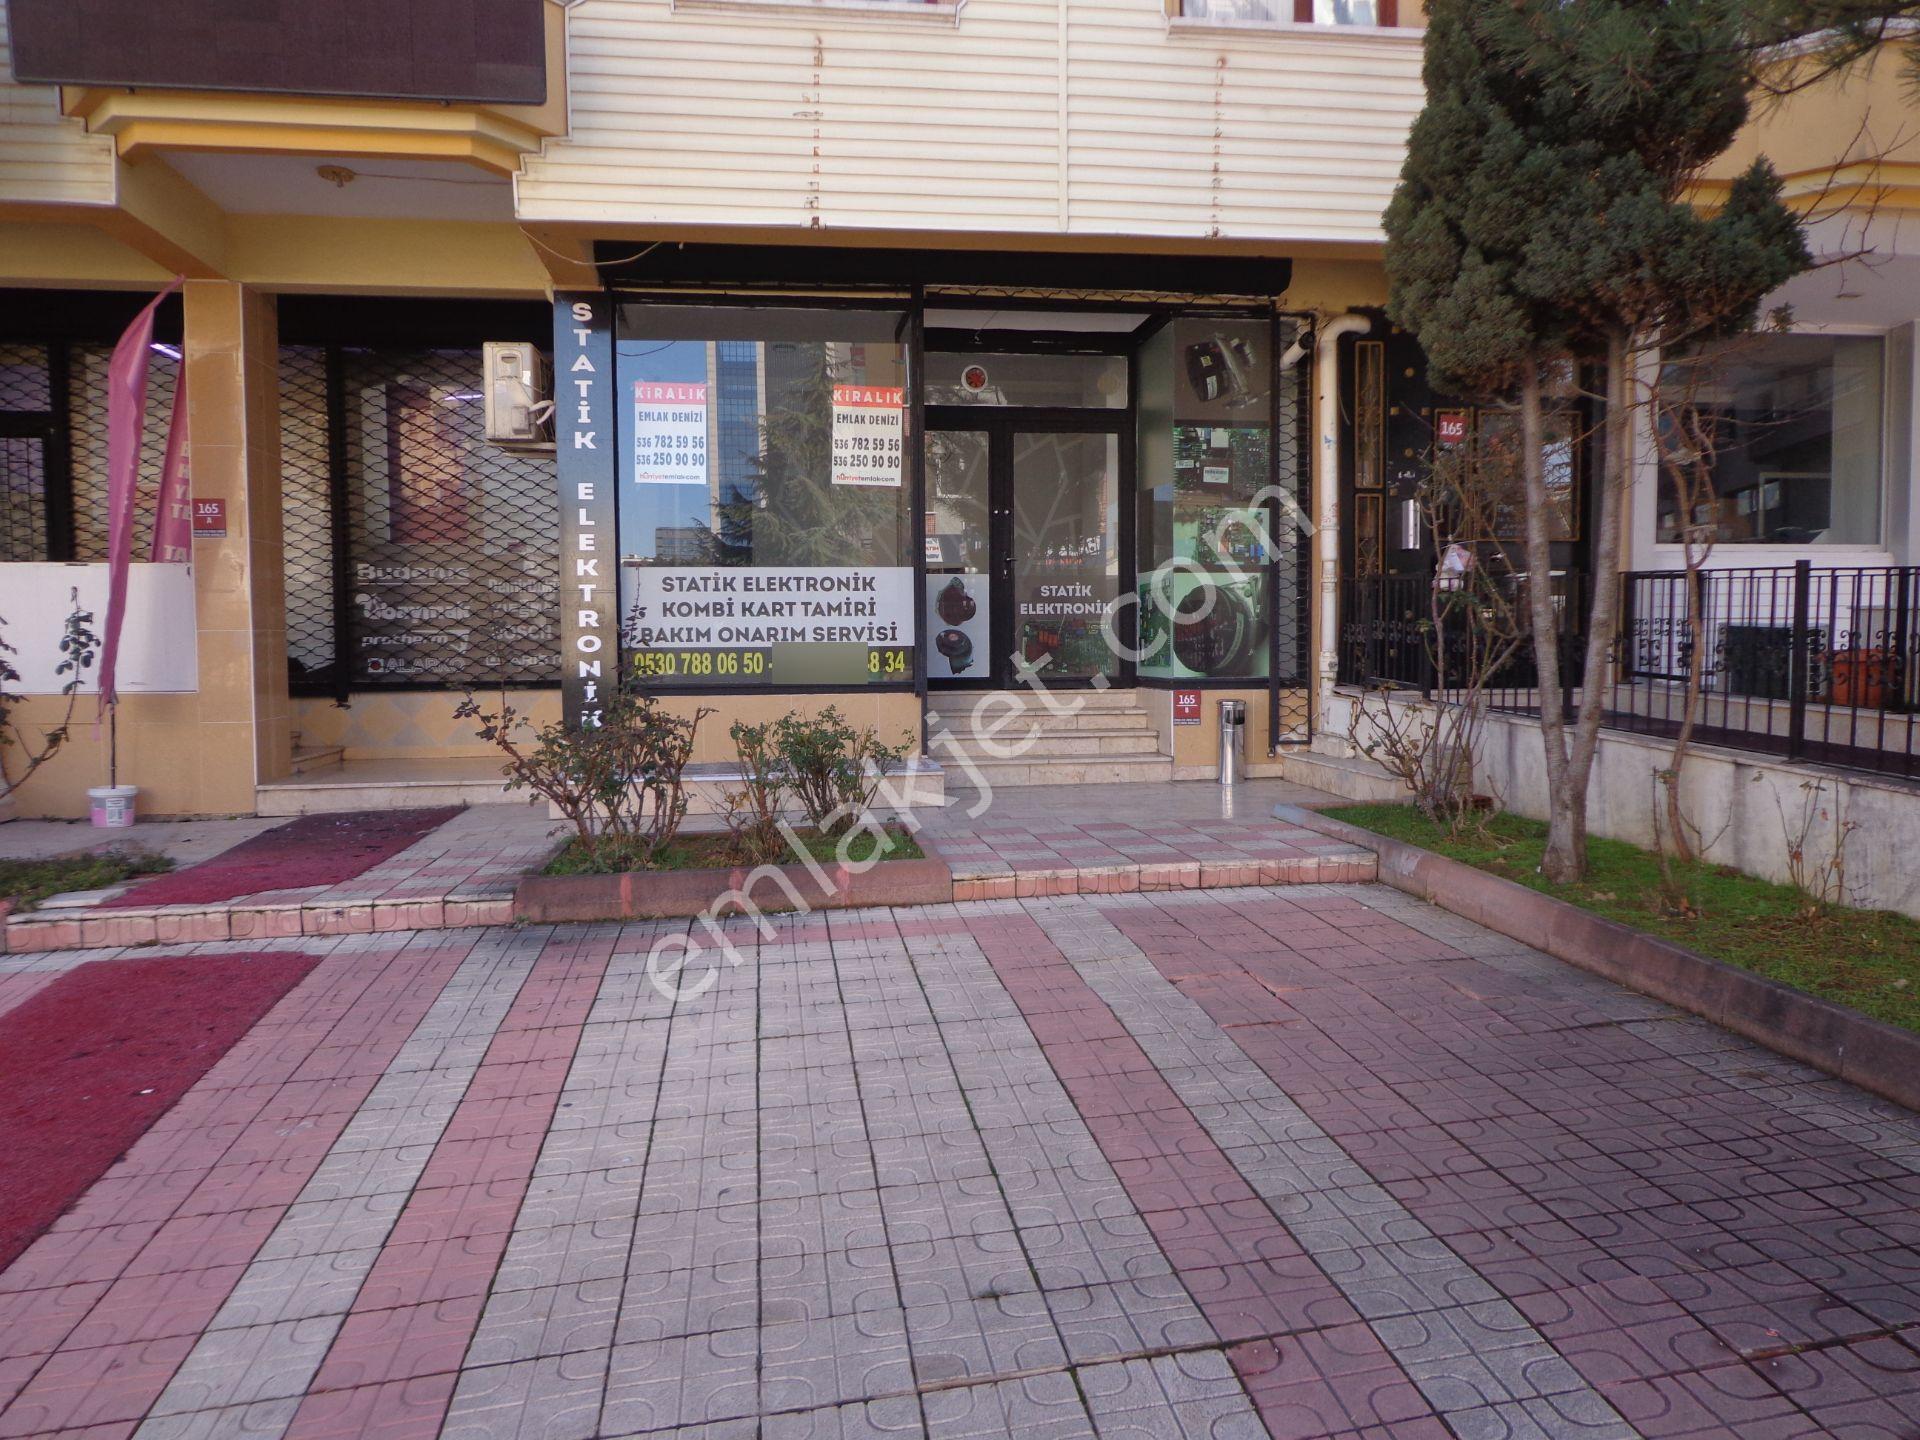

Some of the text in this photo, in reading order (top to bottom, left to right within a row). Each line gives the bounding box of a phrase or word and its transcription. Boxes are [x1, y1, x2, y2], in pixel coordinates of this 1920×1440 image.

[570, 303, 597, 449] STATİK
[639, 411, 703, 423] EMLAK DENİZİ
[837, 413, 899, 426] EMLAK DENİZİ
[1441, 421, 1464, 435] 165
[636, 435, 704, 449] 536 782 59 56
[834, 437, 900, 452] 536 782 59 56
[636, 452, 705, 466] 536 250 90 90
[833, 454, 900, 468] 536 250 90 90
[198, 503, 219, 514] 165
[661, 571, 876, 592] STATİK ELEKTRONİK
[1040, 582, 1092, 597] STATİK
[662, 596, 877, 617] KOMBİ KART TAMİRİ
[1020, 600, 1114, 615] ELEKTRONİK
[640, 621, 899, 643] BAKIM ONARIM SERVİSİ
[634, 650, 905, 675] 0530 788 06 50 8 34
[1178, 694, 1196, 705] 165
